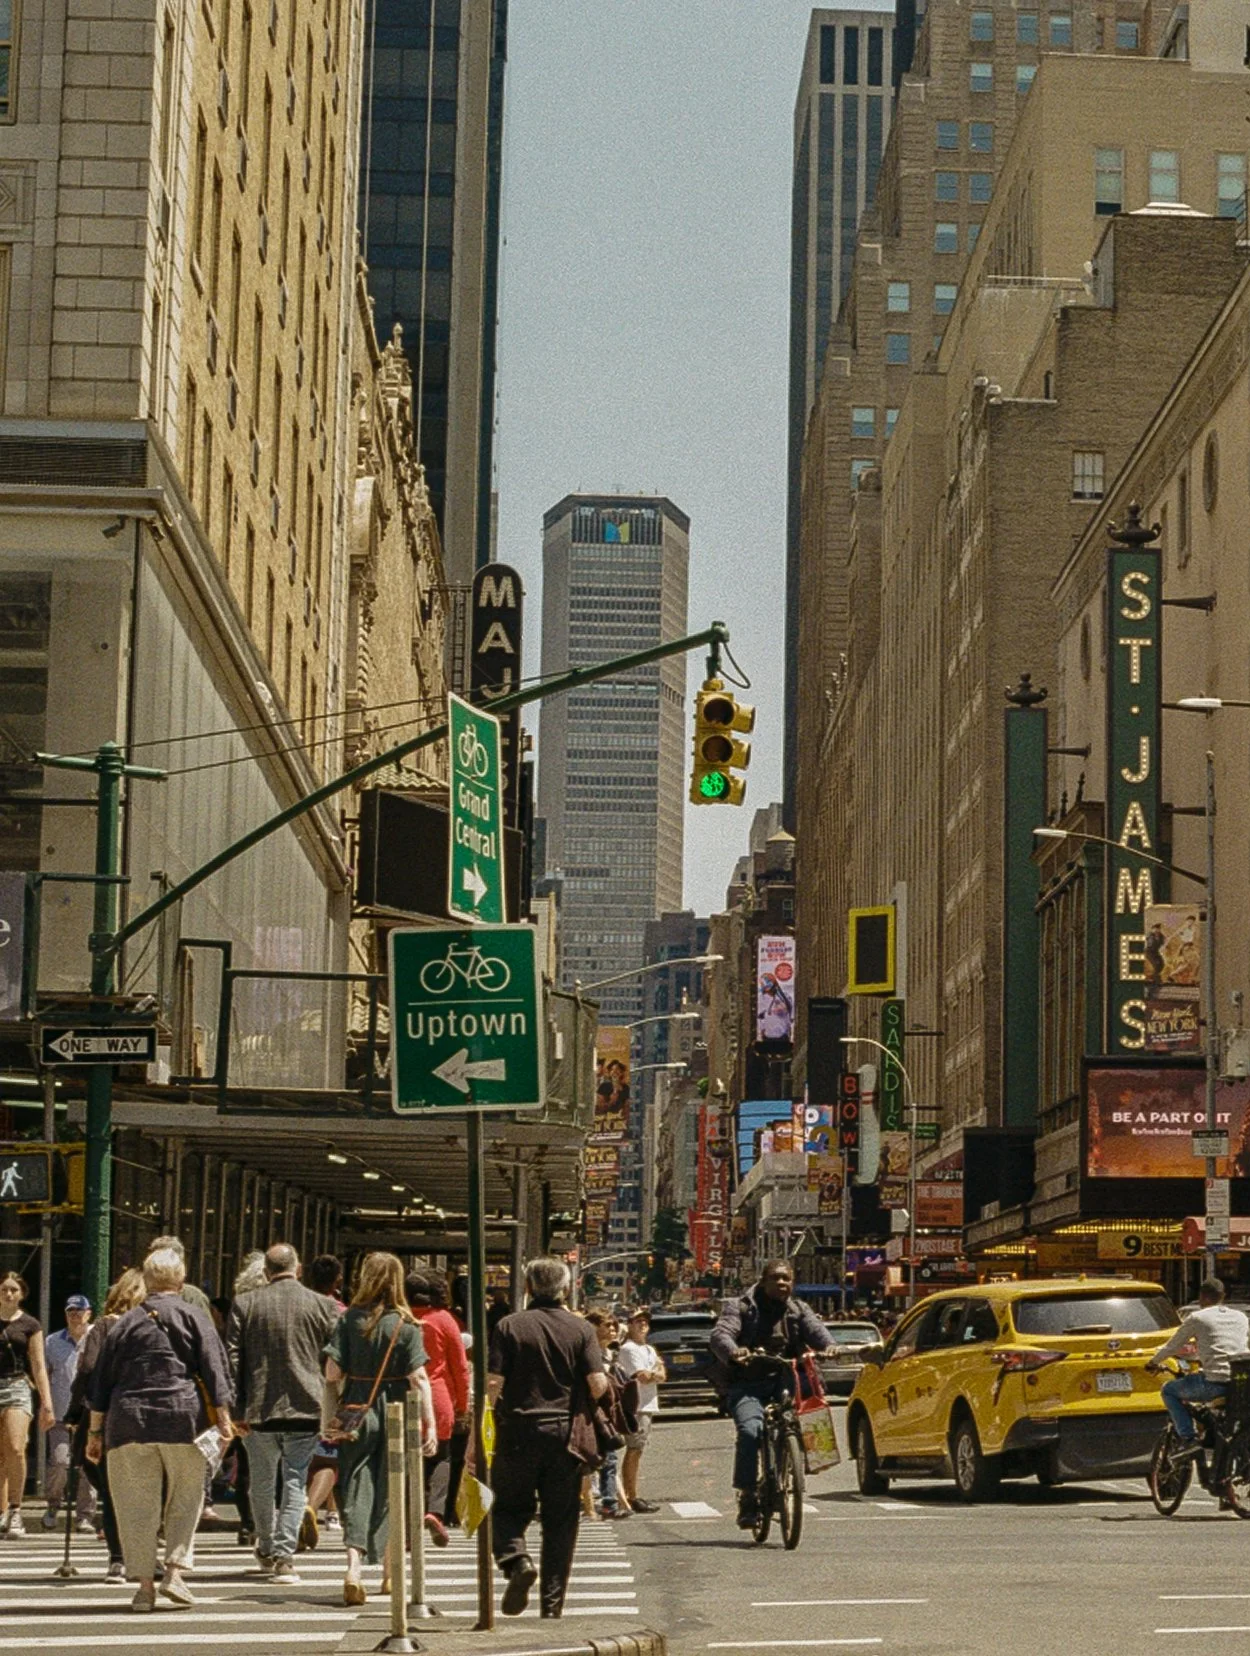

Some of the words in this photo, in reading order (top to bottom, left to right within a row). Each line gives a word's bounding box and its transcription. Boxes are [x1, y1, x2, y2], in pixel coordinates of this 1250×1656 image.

[458, 782, 490, 821] Grand
[456, 817, 496, 860] Central
[407, 1010, 526, 1045] Uptown
[59, 1039, 91, 1053] ONE
[107, 1039, 142, 1053] WAY
[1112, 1112, 1132, 1123] BE
[1135, 1112, 1147, 1123] A
[1151, 1112, 1190, 1123] PART
[1217, 1112, 1231, 1123] IT
[1123, 1235, 1142, 1256] 9
[1143, 1240, 1169, 1257] BEST
